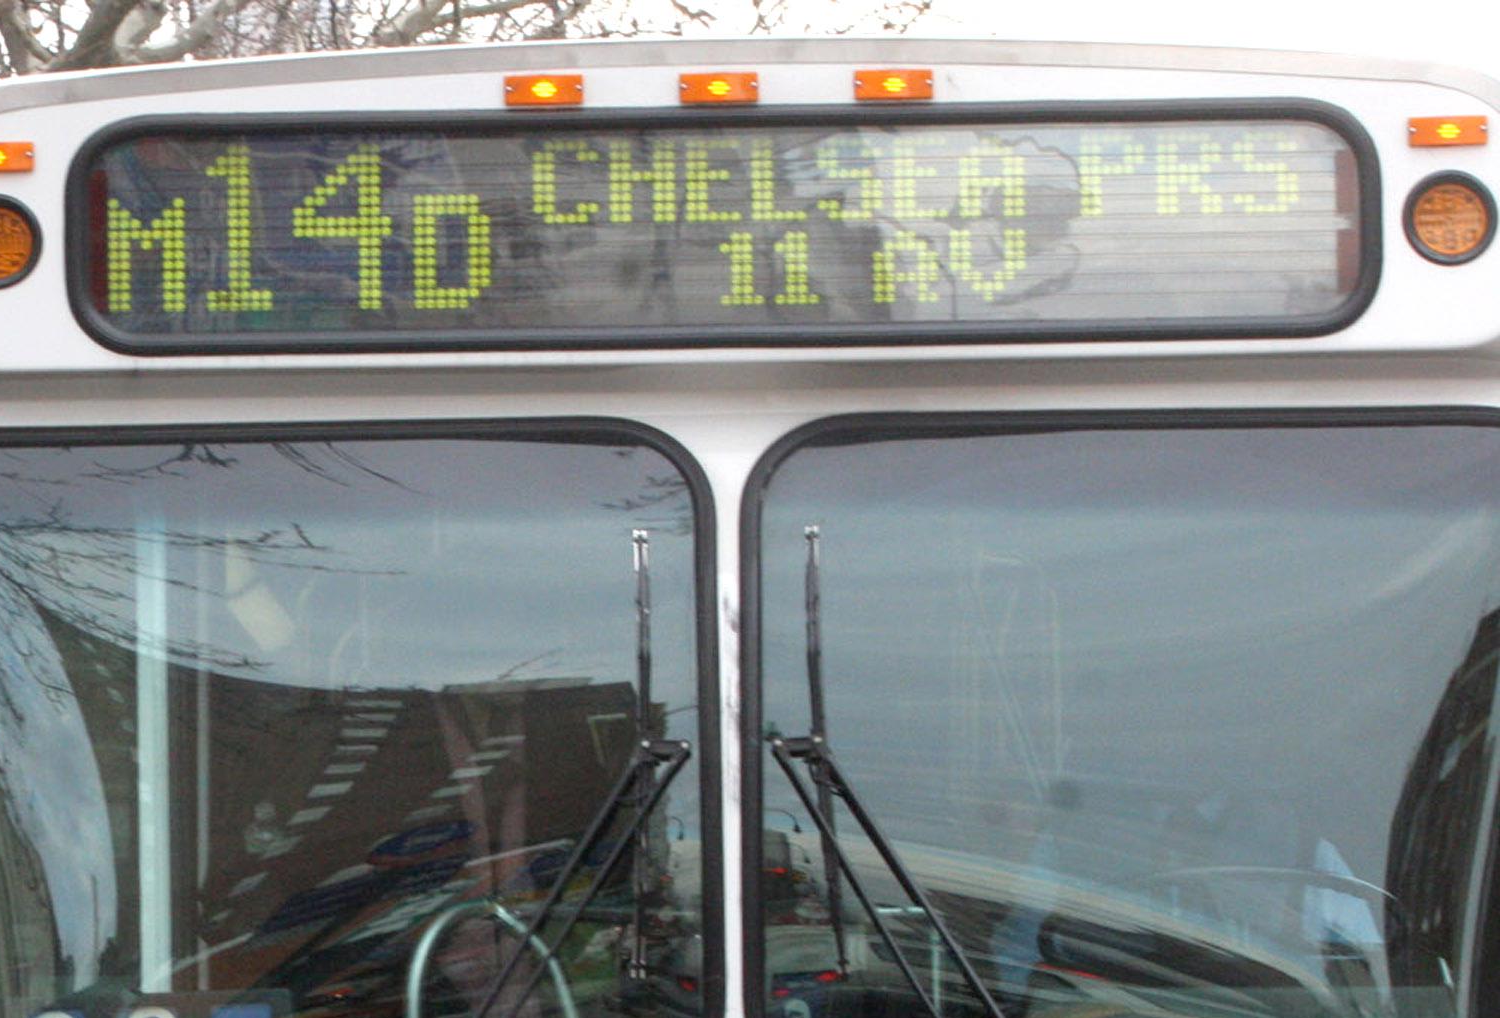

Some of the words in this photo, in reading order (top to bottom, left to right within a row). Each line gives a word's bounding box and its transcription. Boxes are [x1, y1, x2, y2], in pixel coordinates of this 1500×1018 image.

[532, 138, 1026, 223] CHELSEA
[1079, 132, 1300, 216] PKS
[719, 230, 819, 306] 11
[872, 228, 1027, 303] AV
